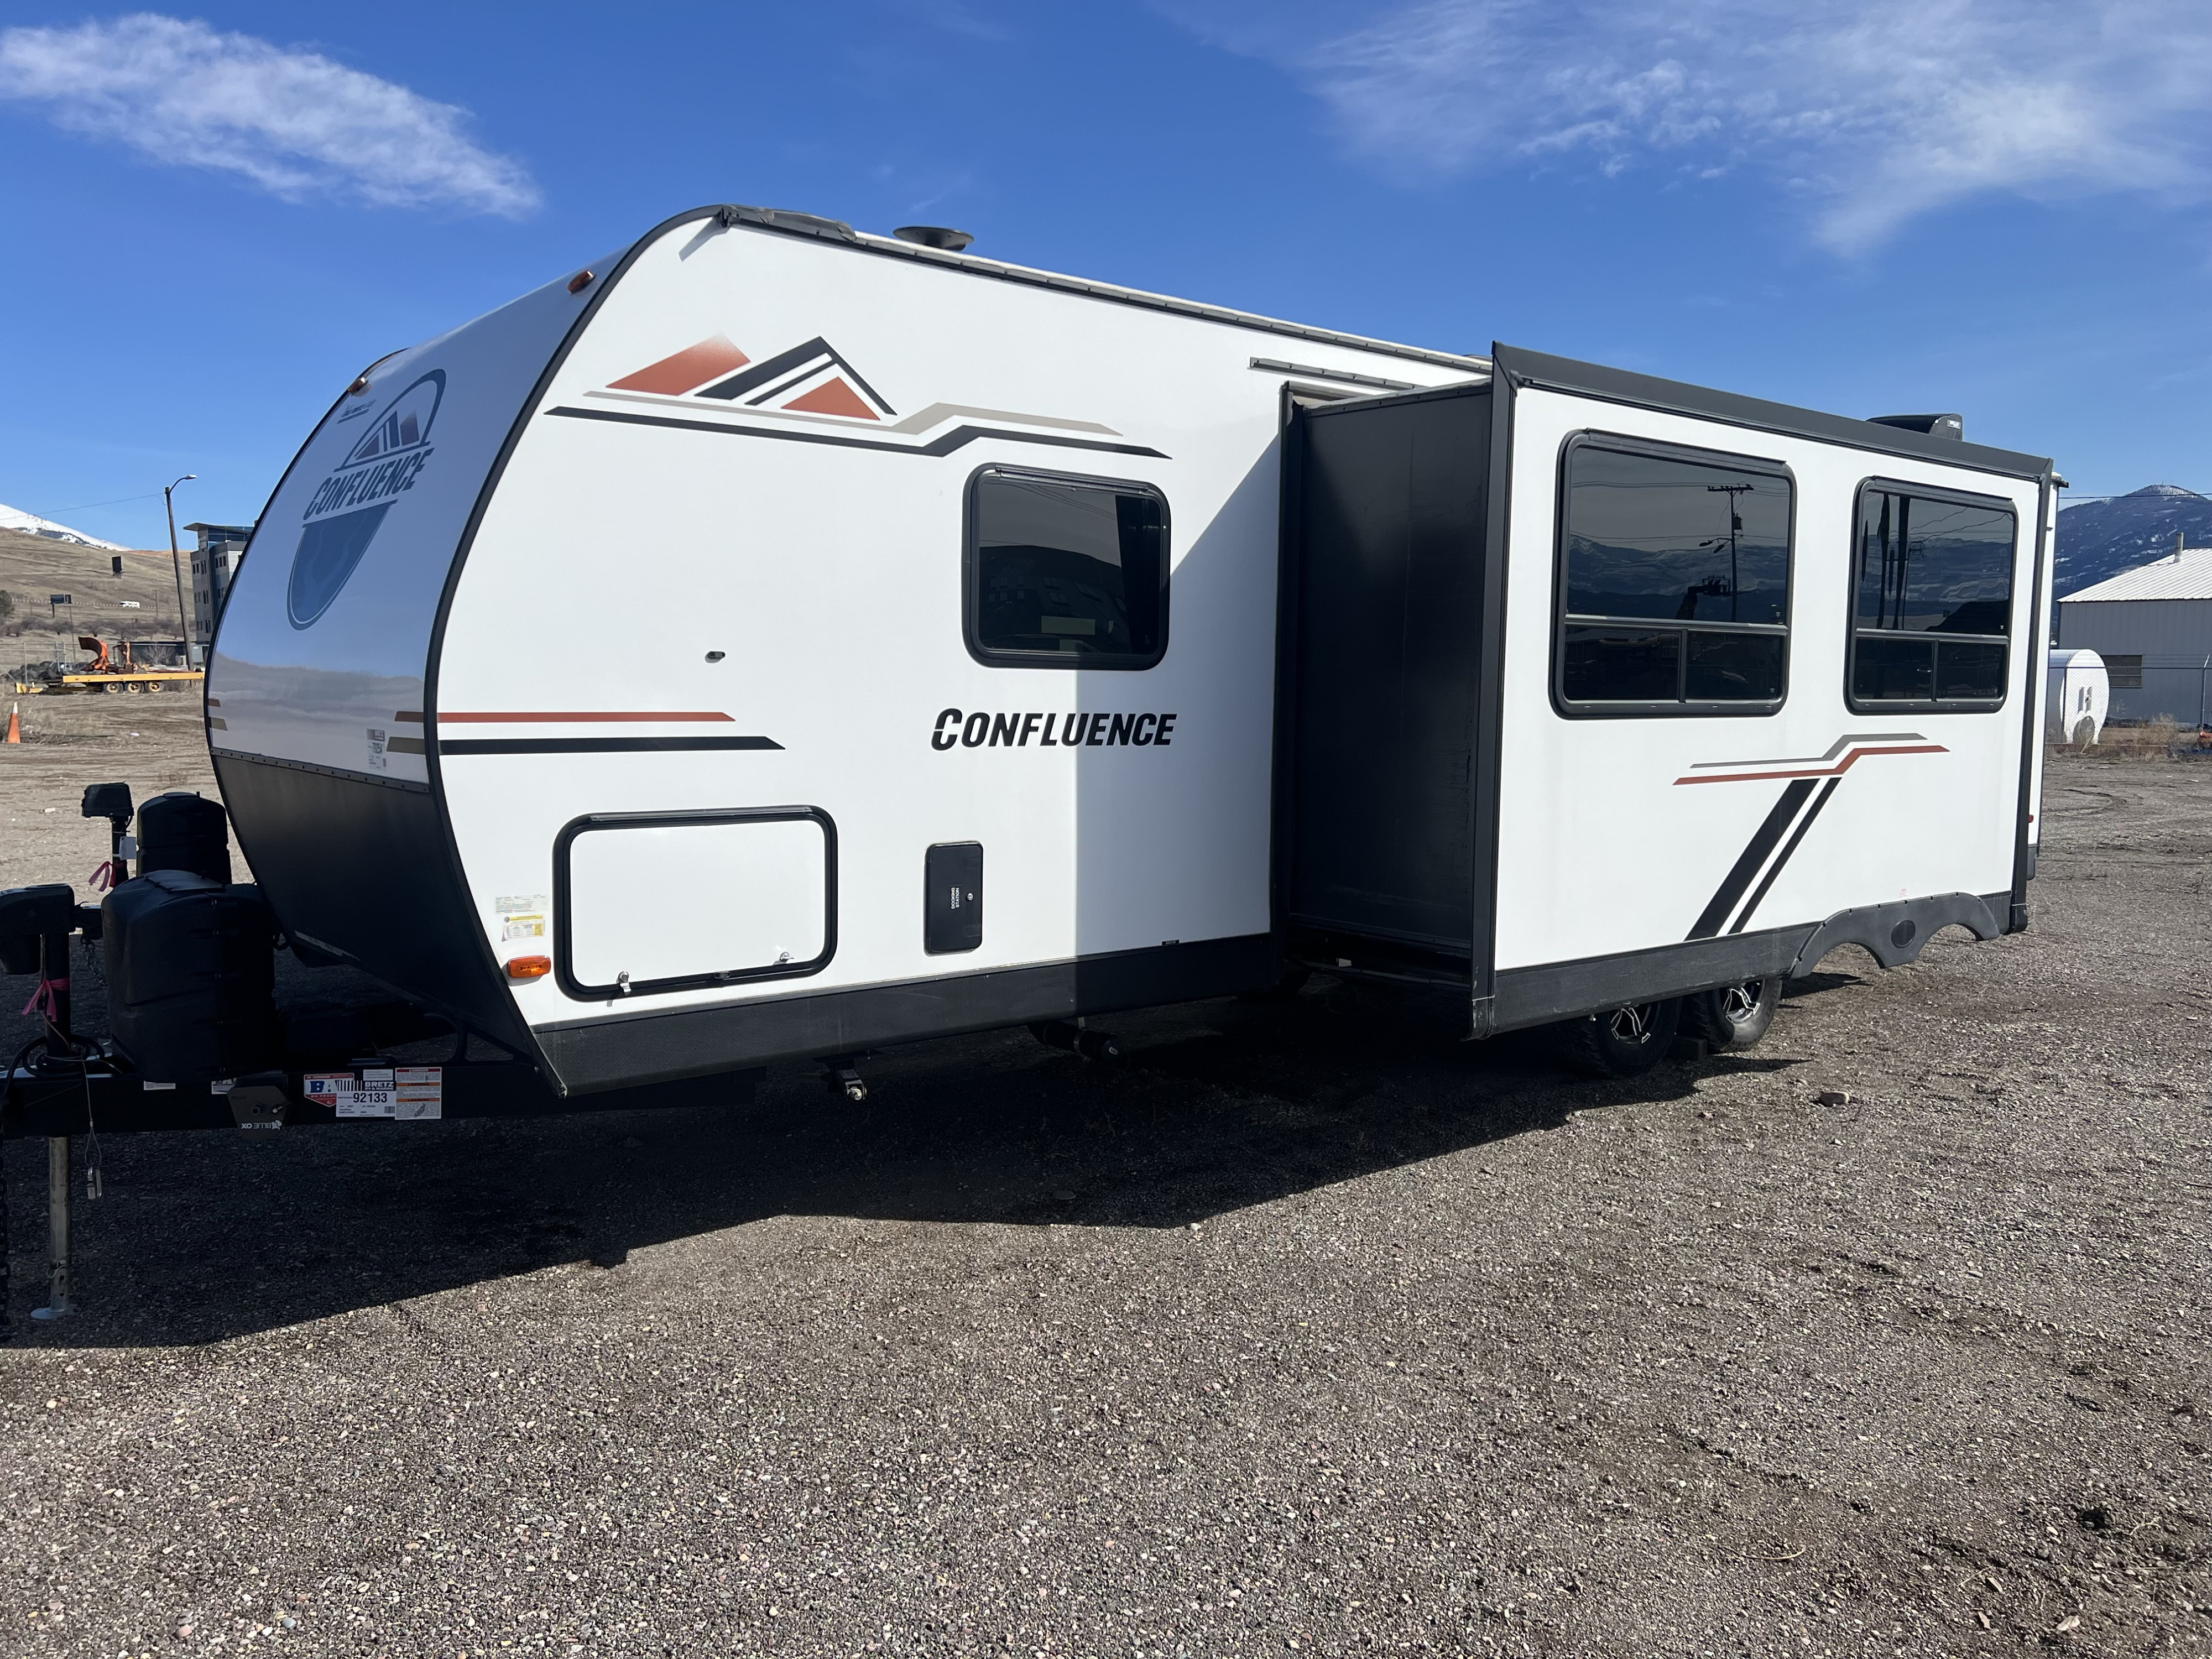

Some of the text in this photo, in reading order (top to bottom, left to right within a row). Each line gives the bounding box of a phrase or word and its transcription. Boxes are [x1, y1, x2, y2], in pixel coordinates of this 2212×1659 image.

[303, 447, 435, 520] CONFLUENCE
[931, 708, 1177, 751] CONFLUENCE
[353, 1092, 388, 1103] 92133
